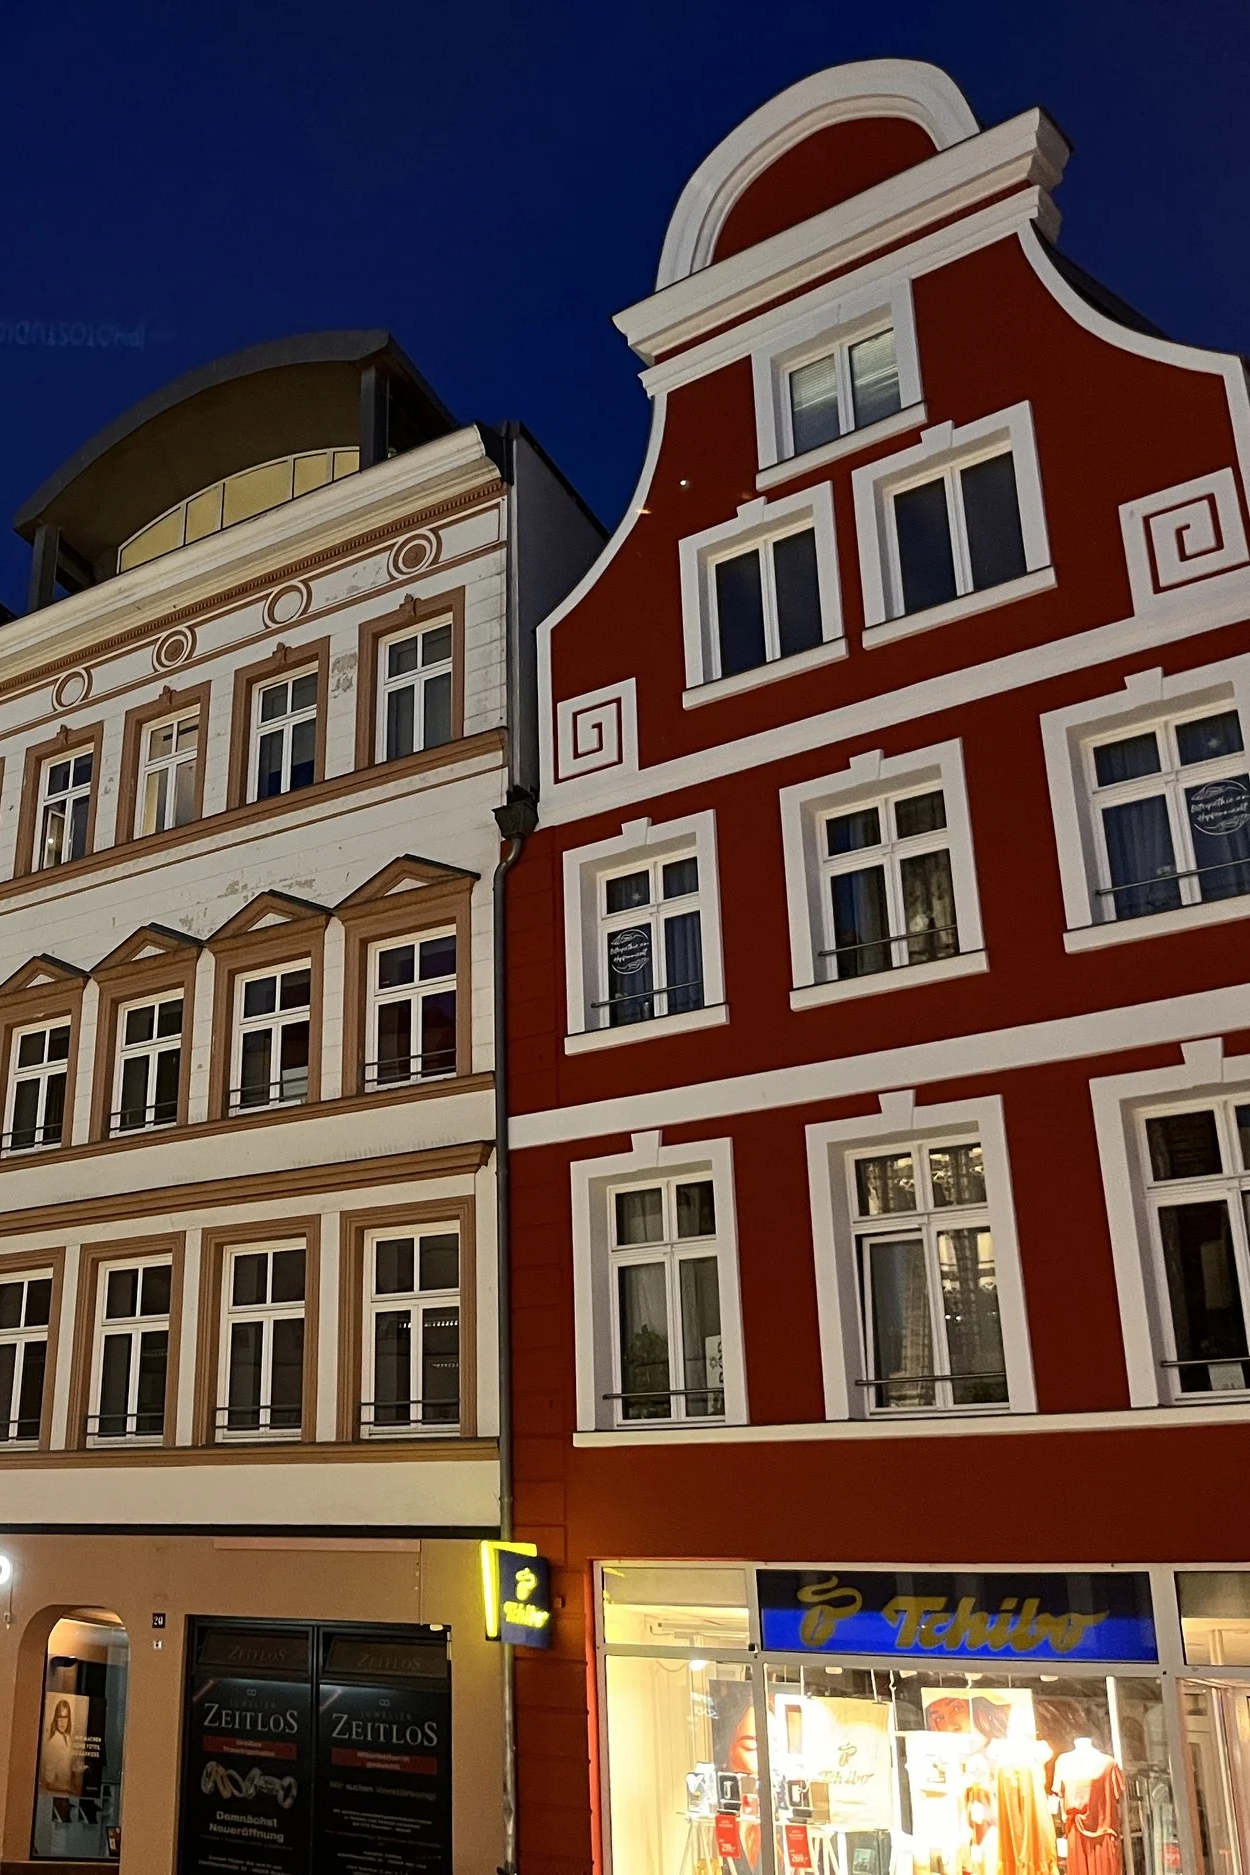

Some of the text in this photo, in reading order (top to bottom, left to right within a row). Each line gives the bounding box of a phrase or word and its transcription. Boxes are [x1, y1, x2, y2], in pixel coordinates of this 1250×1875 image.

[881, 1596, 1110, 1654] Tchibo
[203, 1703, 299, 1735] ZEITLOS
[332, 1712, 440, 1748] ZEITLOS
[209, 1822, 285, 1843] Neueröffnung
[216, 1810, 278, 1828] Demnächst
